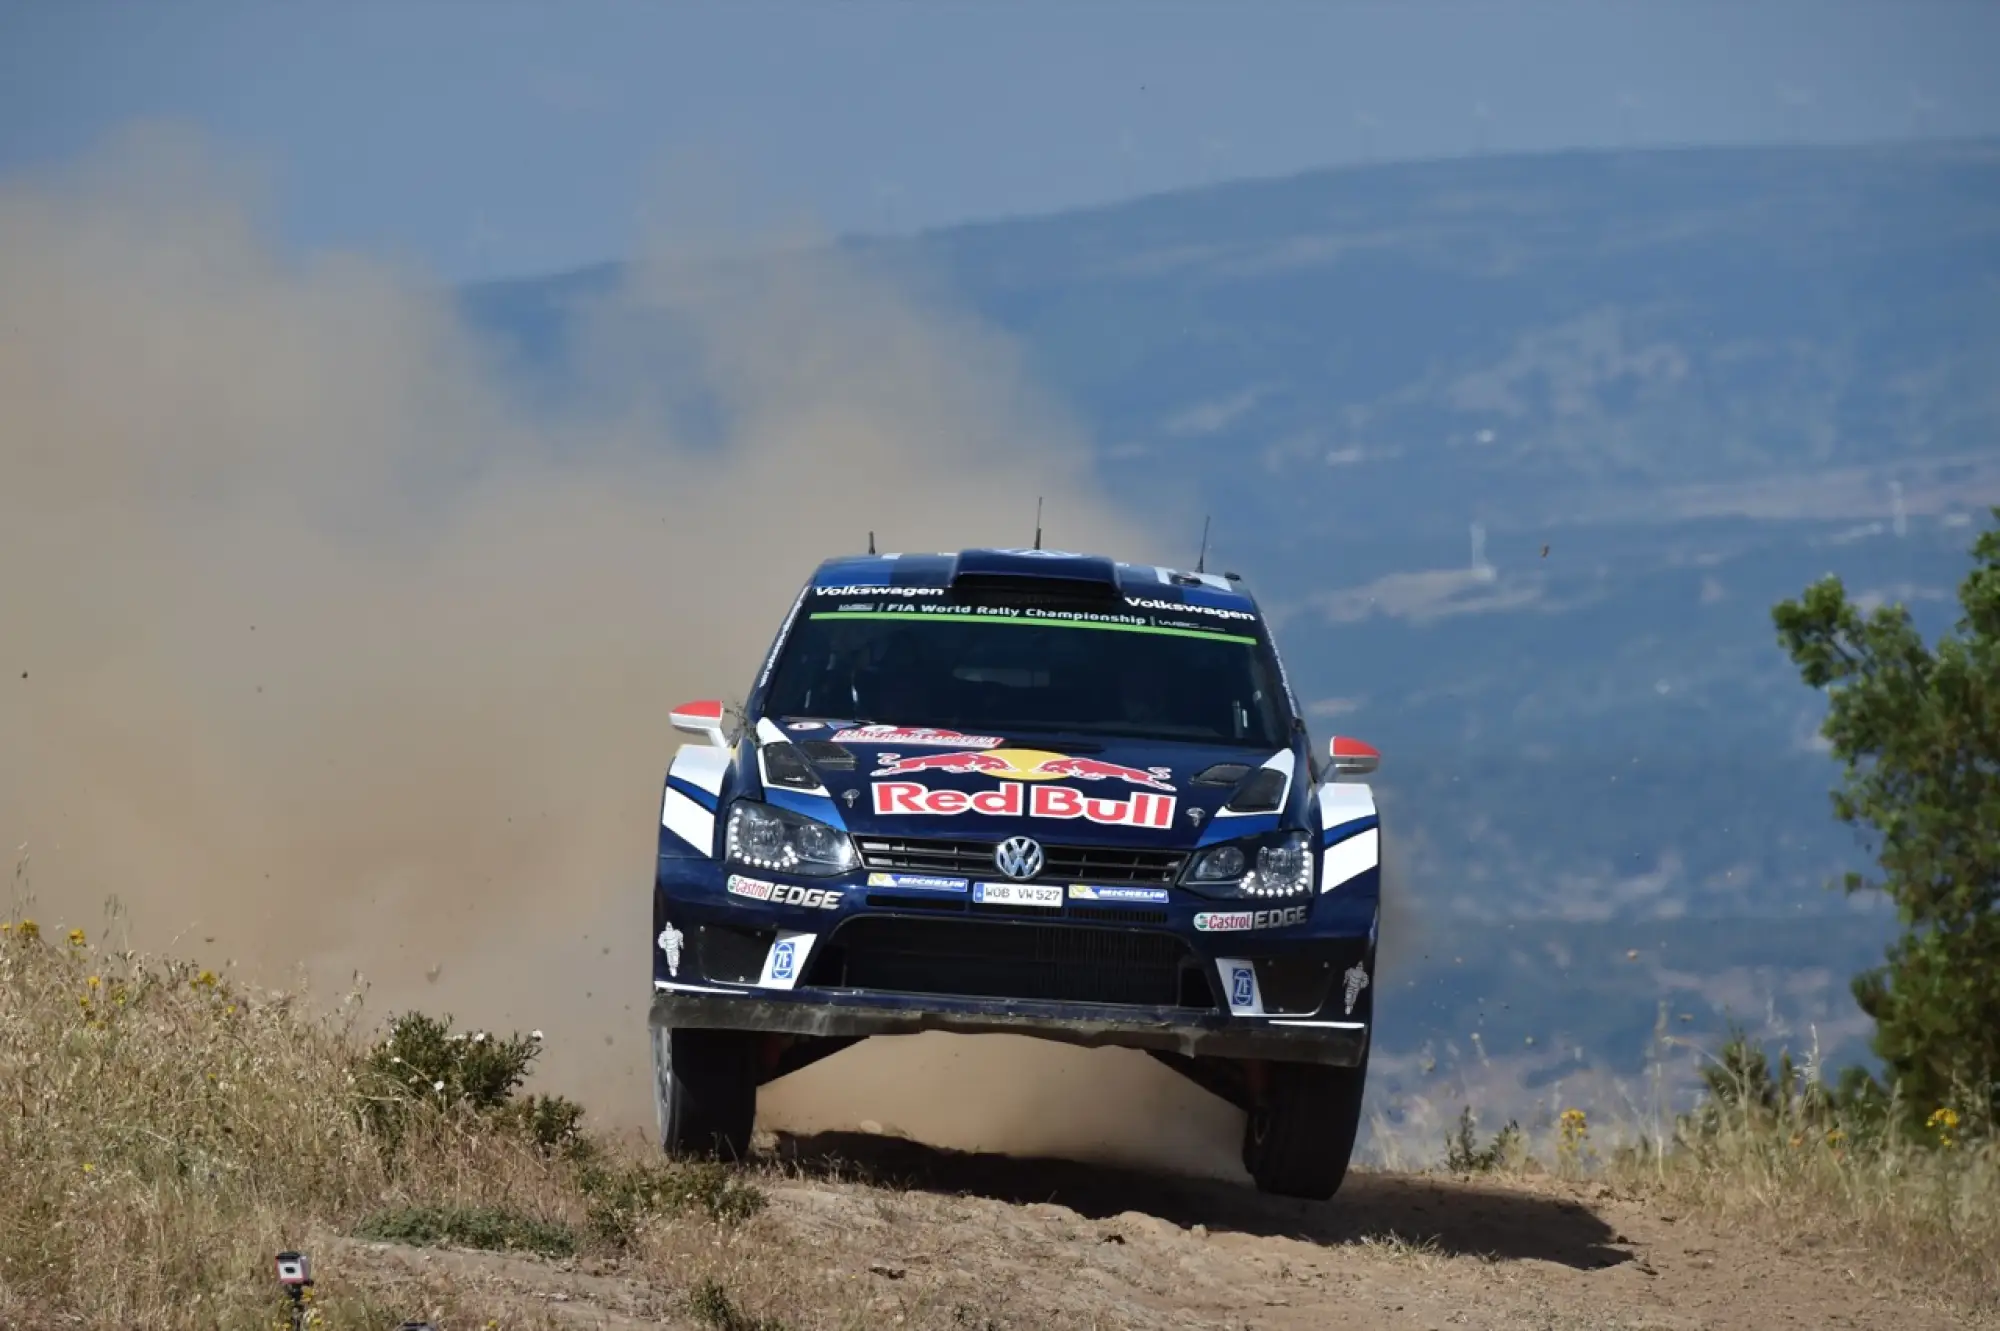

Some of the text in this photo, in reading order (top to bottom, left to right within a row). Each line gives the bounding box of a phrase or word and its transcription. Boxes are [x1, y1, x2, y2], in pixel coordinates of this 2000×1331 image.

[815, 586, 944, 598] Volkswagen
[887, 603, 1147, 626] FIA World Rally Championship
[1124, 596, 1256, 621] Volkswagen
[873, 782, 1175, 829] Red Bull
[735, 879, 844, 910] Castrol EDGE
[1035, 889, 1060, 901] 527
[1208, 905, 1307, 930] Castrol EDGE
